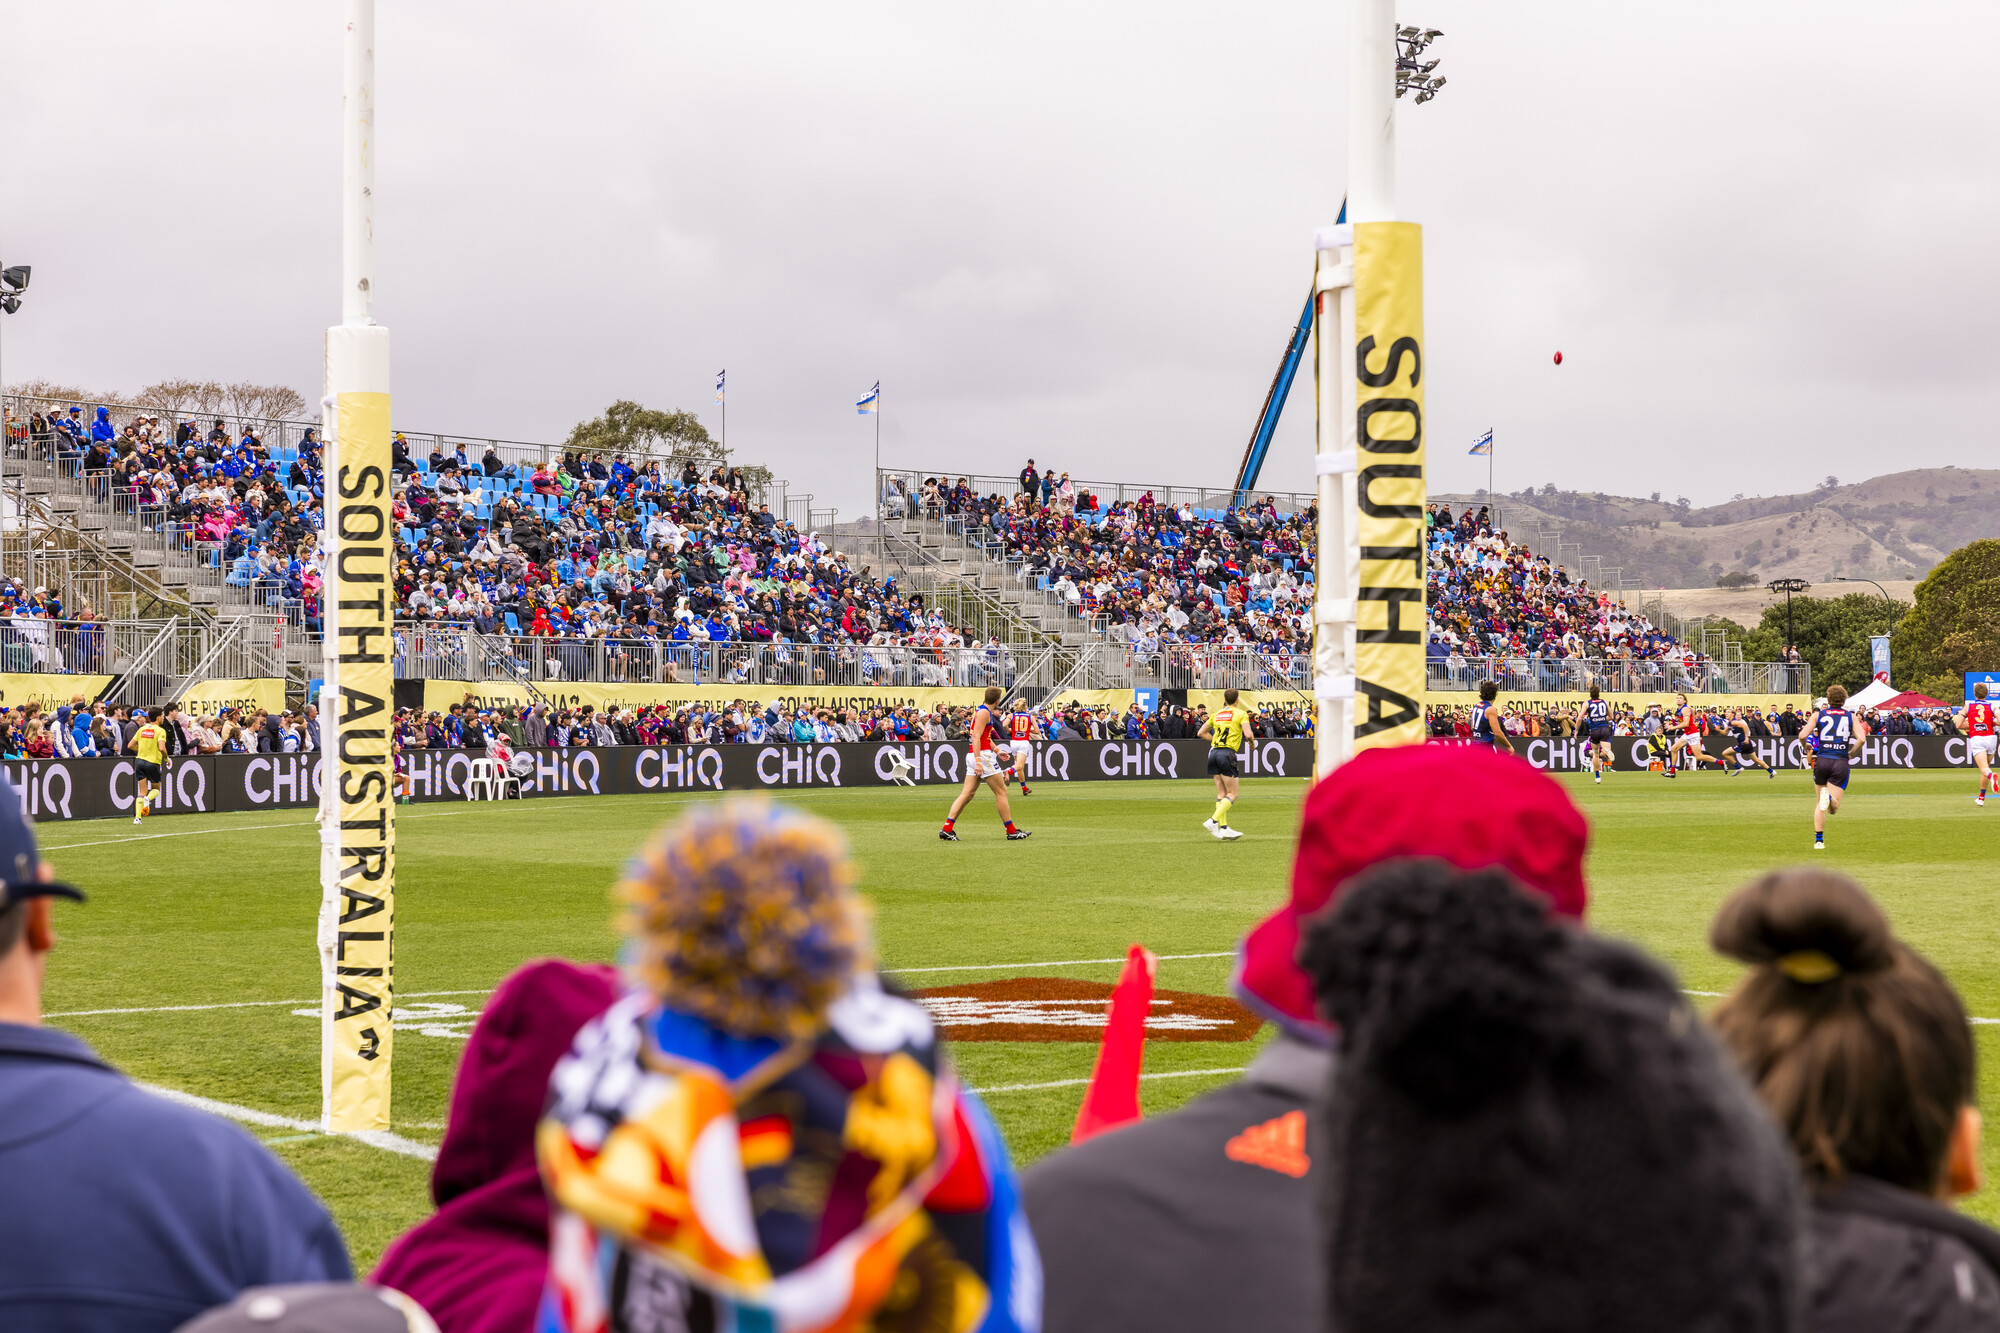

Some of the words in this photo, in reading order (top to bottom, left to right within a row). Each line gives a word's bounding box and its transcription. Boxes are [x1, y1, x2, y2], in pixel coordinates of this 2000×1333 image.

[1356, 334, 1423, 645] SOUTH
[338, 464, 385, 664] SOUTH
[177, 700, 198, 718] PLE
[201, 698, 257, 718] PLESURES
[602, 698, 646, 714] Clebrate
[666, 699, 701, 714] SIM
[1014, 715, 1029, 732] 10
[1471, 706, 1485, 730] 17
[1507, 700, 1549, 716] SOUTH
[1552, 700, 1620, 716] AUSTIA
[1589, 702, 1607, 718] 20
[1974, 704, 1985, 723] 3
[1819, 715, 1851, 742] 24
[635, 745, 724, 790] CHiQ
[756, 743, 841, 787] CHiQ
[874, 742, 959, 783] CHiQ
[997, 741, 1070, 781] HiQ
[1099, 740, 1178, 779] CHiQ
[1208, 739, 1286, 777] HiQ
[1527, 737, 1587, 769] CHi
[4, 760, 73, 819] HiQ
[109, 757, 206, 812] CiQ
[393, 750, 475, 799] HiQ
[334, 685, 387, 1022] AUSTRALIA
